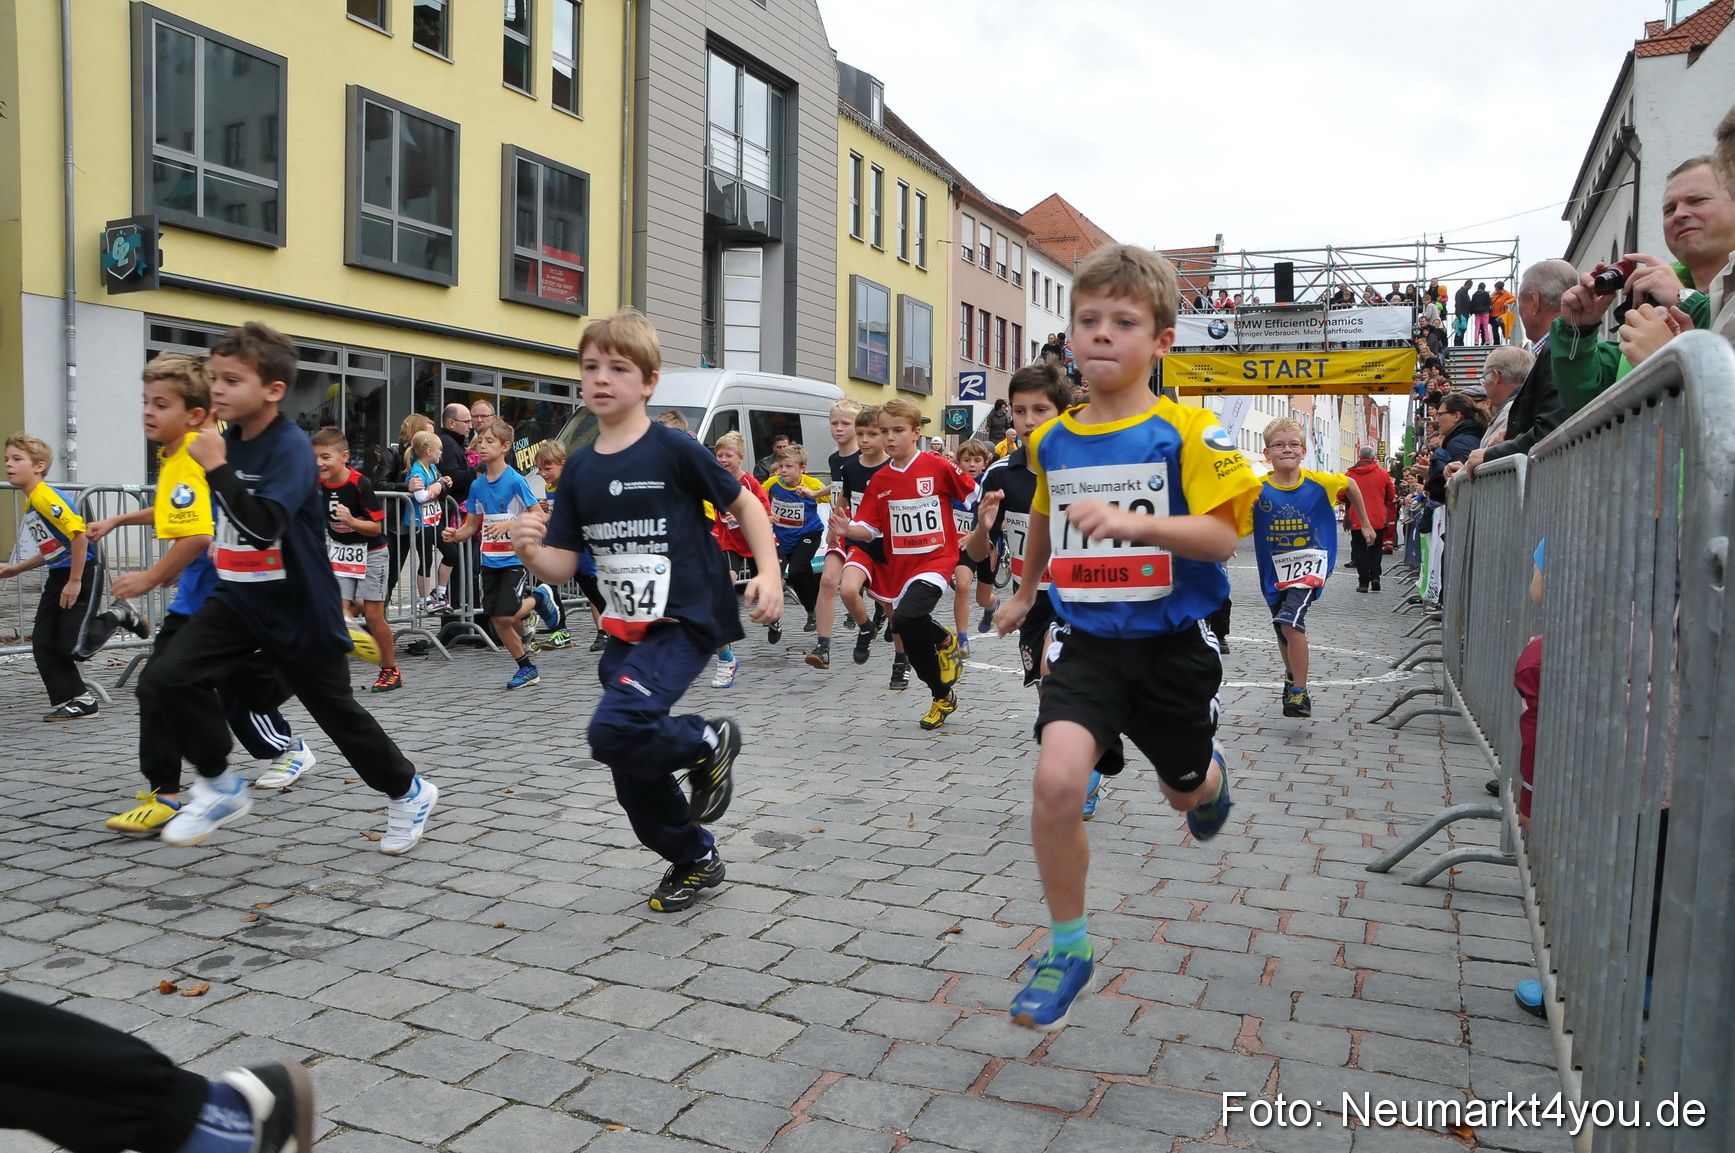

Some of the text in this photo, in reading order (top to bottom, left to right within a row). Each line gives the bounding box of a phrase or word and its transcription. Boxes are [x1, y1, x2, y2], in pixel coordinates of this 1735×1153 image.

[112, 236, 130, 267] G2
[1265, 317, 1363, 328] EfficientDynamics
[1303, 328, 1322, 336] Mehr
[1242, 359, 1330, 379] START
[1051, 479, 1142, 496] PARTL Neumarkt
[774, 505, 801, 520] 7225
[902, 503, 930, 511] Neumarkt
[892, 510, 937, 534] 7016
[903, 538, 928, 546] Fabian
[330, 547, 364, 563] 7038
[1071, 564, 1129, 583] Marius
[1281, 558, 1323, 581] 7231
